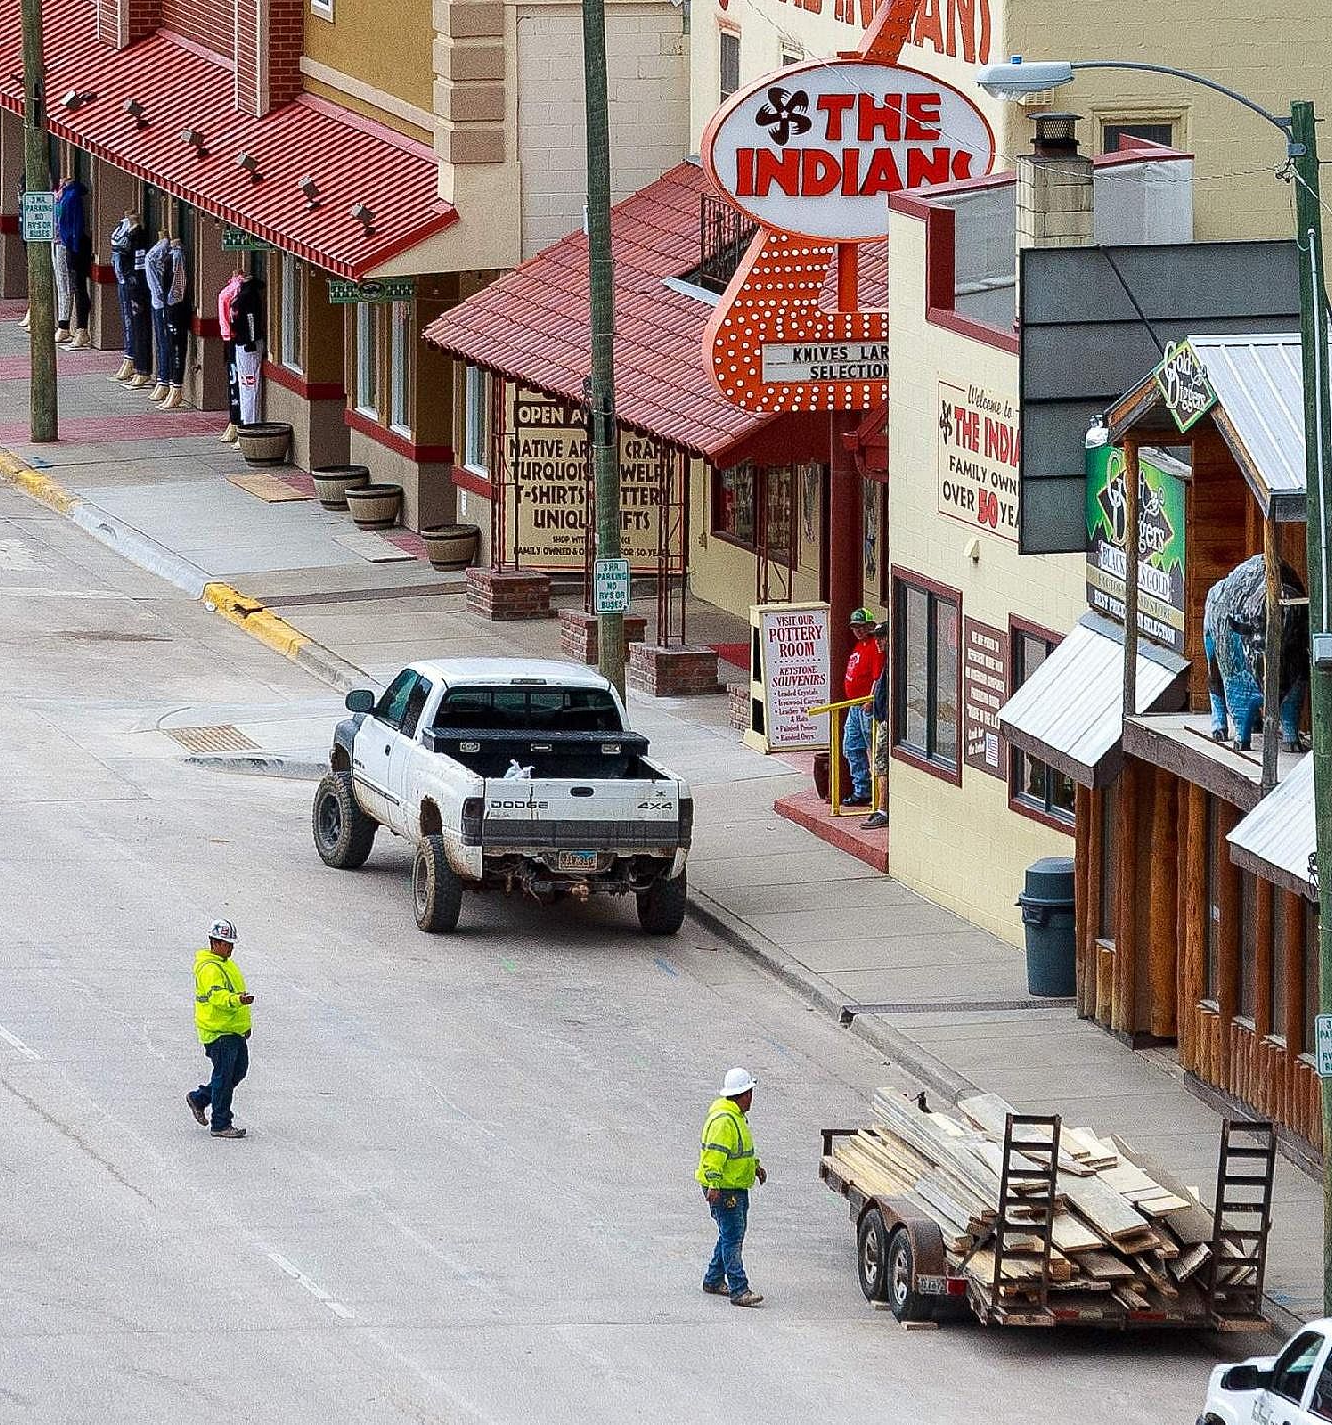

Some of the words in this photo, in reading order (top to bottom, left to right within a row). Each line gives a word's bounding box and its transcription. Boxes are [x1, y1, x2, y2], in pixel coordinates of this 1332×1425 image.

[816, 93, 942, 143] THE
[792, 346, 848, 362] KNIVES
[859, 345, 889, 360] LAR
[810, 364, 889, 380] SELECTION
[968, 384, 1002, 416] Welcome
[1003, 400, 1013, 419] to
[519, 407, 564, 425] OPEN
[954, 406, 980, 454] THE
[509, 439, 563, 458] NATIVE
[949, 455, 988, 483] FAMILY
[517, 485, 585, 505] T-SHIRTS
[942, 480, 975, 512] OVER
[977, 487, 998, 529] 50
[776, 615, 796, 626] VISIT
[798, 614, 814, 625] OUR
[769, 625, 824, 643] POTTERY
[779, 641, 815, 658] ROOM
[779, 665, 818, 676] KEYSTONE
[772, 673, 826, 687] SOUVENIRS
[490, 800, 549, 809] DODGE
